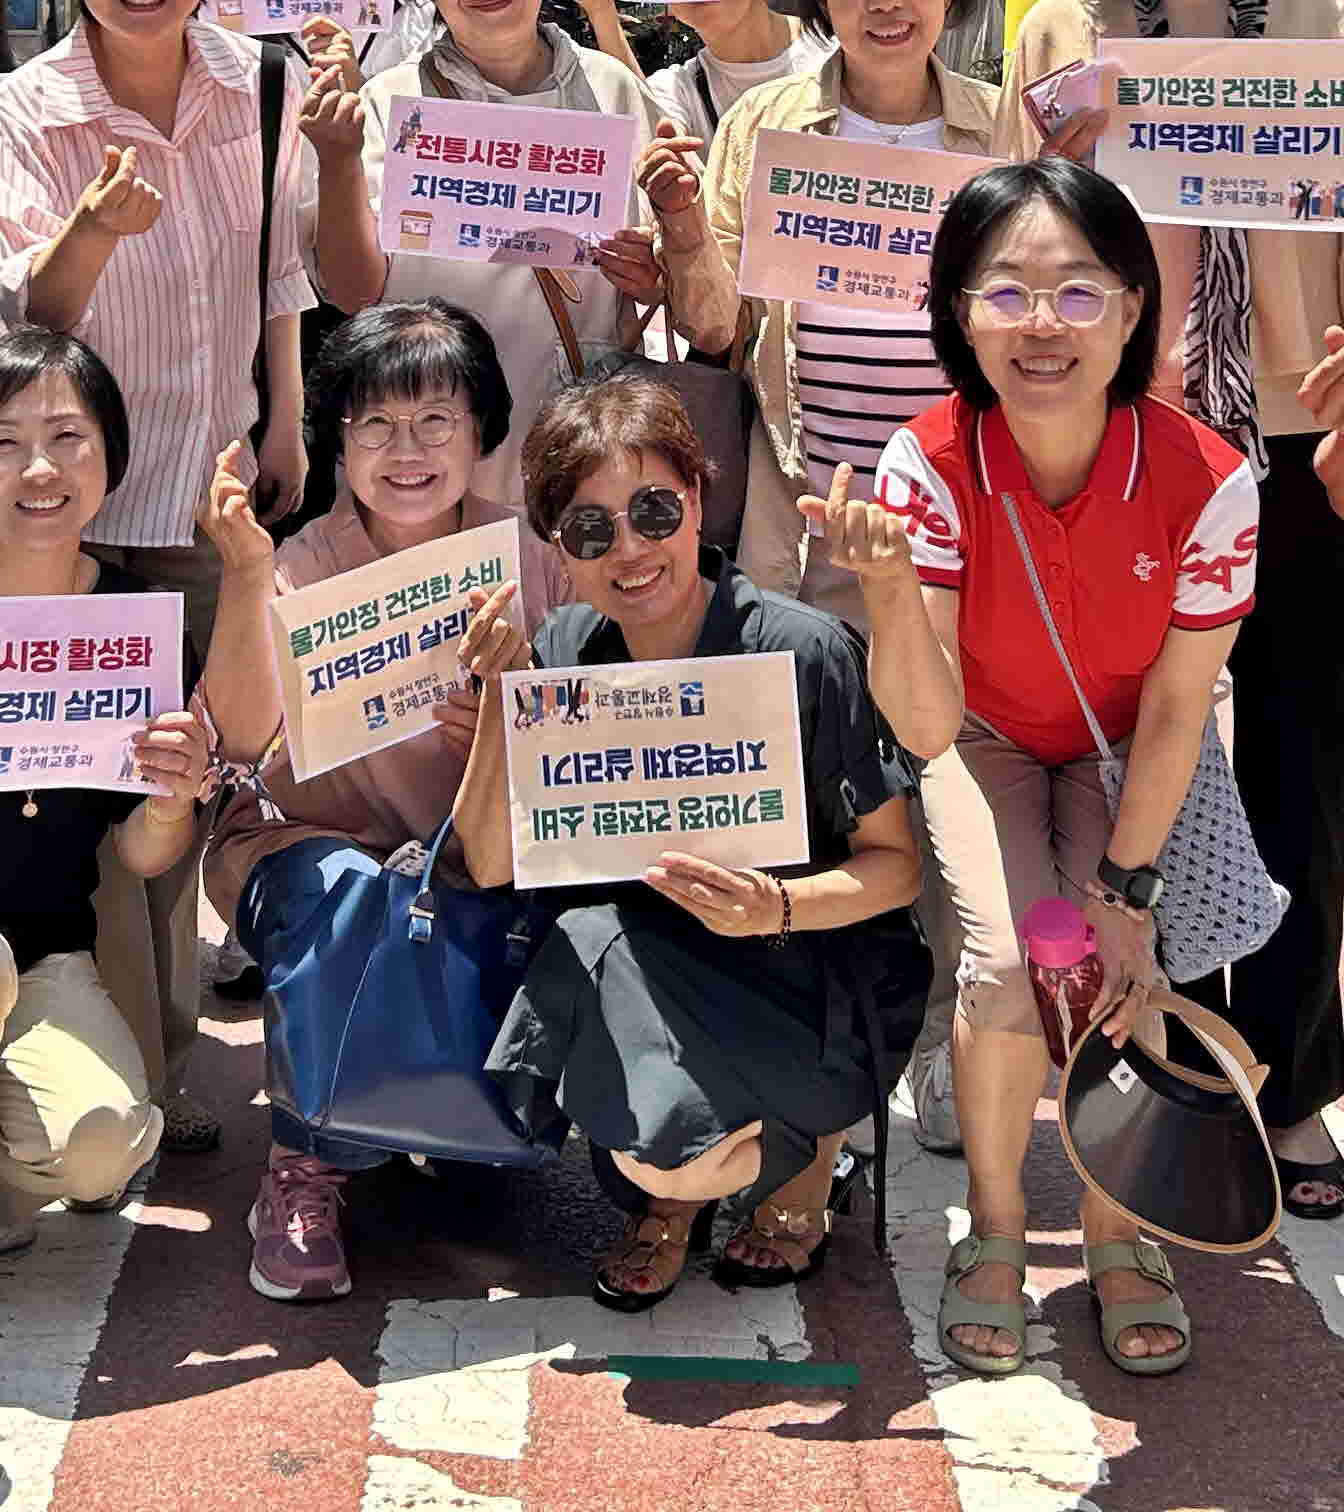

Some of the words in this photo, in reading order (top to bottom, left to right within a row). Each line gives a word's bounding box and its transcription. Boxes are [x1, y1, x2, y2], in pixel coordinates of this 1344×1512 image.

[1117, 77, 1216, 107] 물가안정
[1222, 77, 1298, 108] 건전한
[415, 134, 522, 170] 전통시장
[527, 143, 606, 177] 활성화
[1128, 122, 1244, 153] 지역경제
[1253, 125, 1341, 156] 살리기
[411, 174, 517, 209] 지역경제
[523, 187, 602, 218] 살리기
[769, 167, 861, 205] 물가안정
[864, 179, 935, 215] 건전한
[774, 209, 882, 250] 지역경제
[290, 599, 380, 659] 물가안정
[384, 573, 452, 621] 건전한
[458, 557, 503, 593] 소비
[67, 636, 153, 672] 활성화
[307, 631, 412, 697] 지역경제
[417, 607, 476, 652] 살리
[64, 687, 152, 722] 살리기
[542, 747, 635, 787] 살리기
[641, 740, 768, 781] 지역경제
[533, 805, 585, 841] 소비
[592, 799, 673, 836] 건전한
[678, 789, 785, 831] 물가안정
